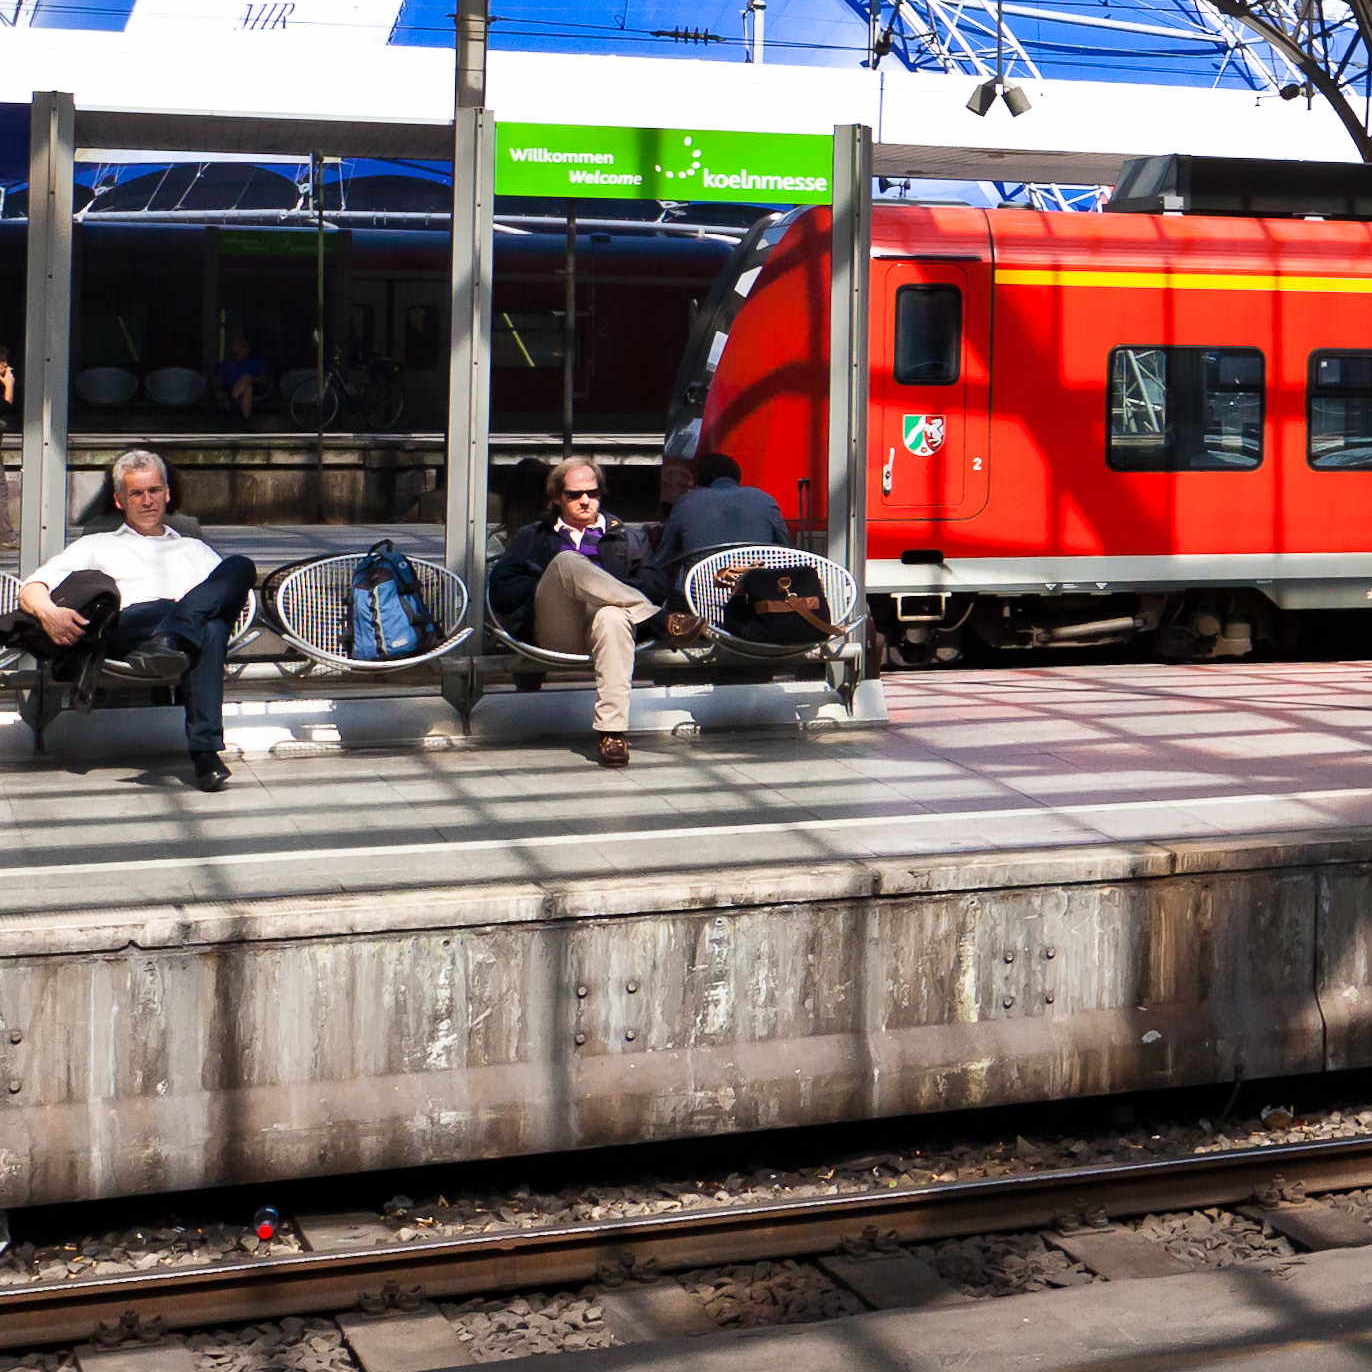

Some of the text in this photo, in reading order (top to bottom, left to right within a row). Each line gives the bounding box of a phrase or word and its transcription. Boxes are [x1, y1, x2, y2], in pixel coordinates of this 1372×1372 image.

[235, 1, 295, 31] MIR
[509, 147, 615, 165] Willkommen
[568, 170, 643, 186] Welcome
[703, 168, 828, 192] koelnmesse
[972, 457, 983, 471] 2
